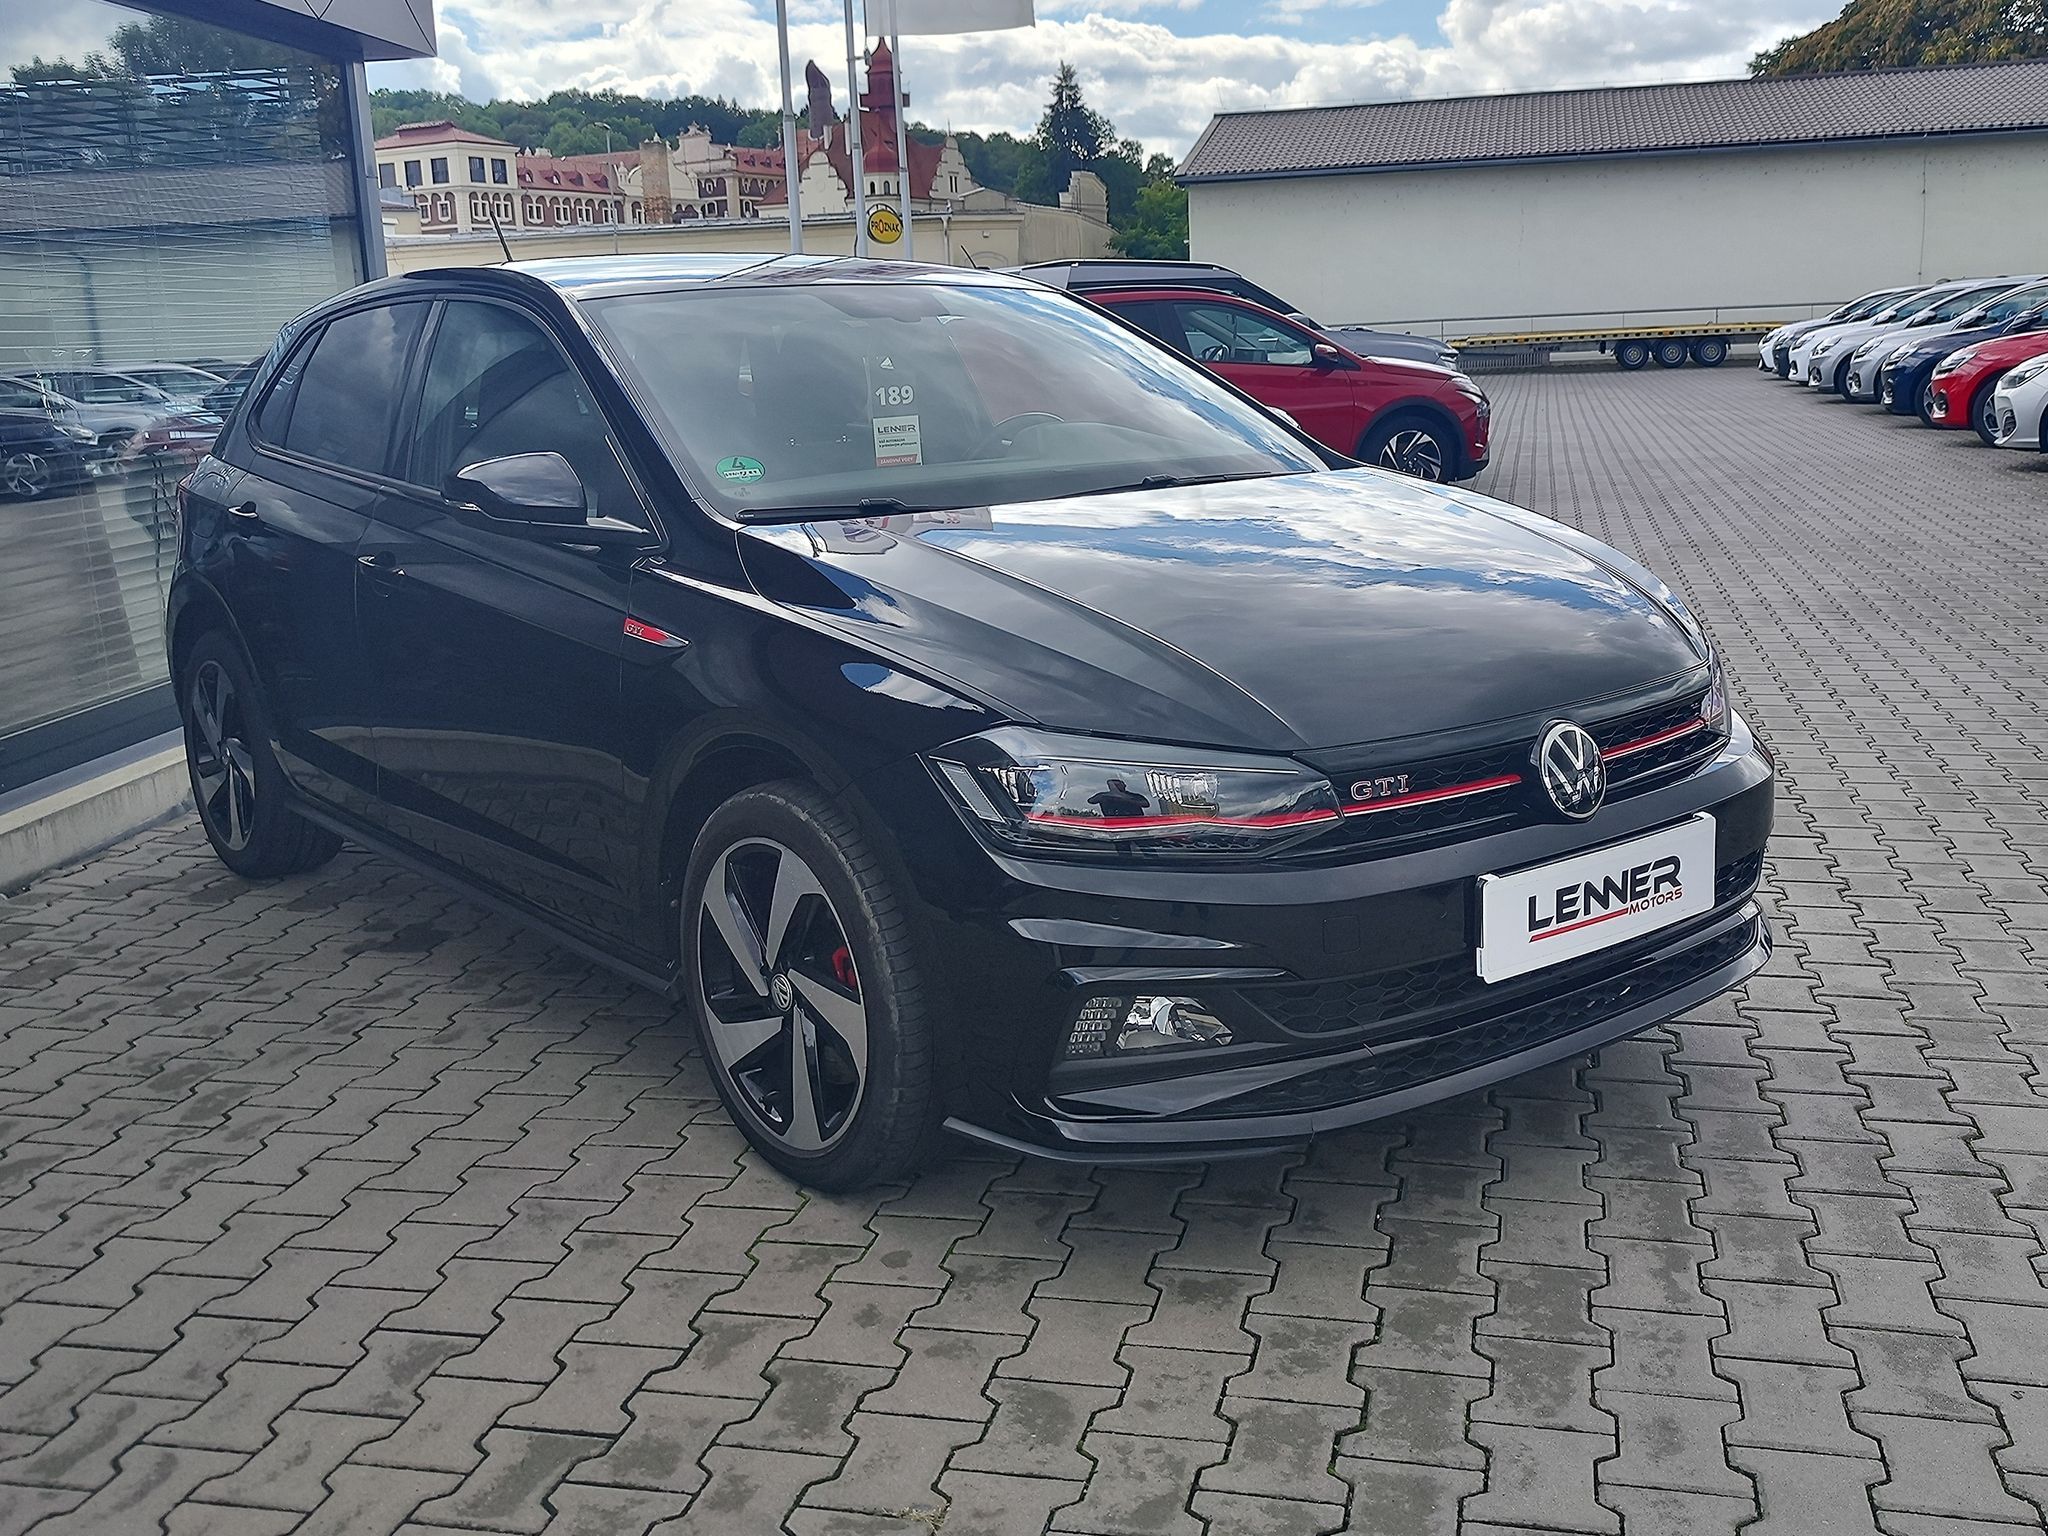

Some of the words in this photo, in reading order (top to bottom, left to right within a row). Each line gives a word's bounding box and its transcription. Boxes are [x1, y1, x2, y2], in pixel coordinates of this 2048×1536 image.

[875, 385, 915, 406] 189
[877, 424, 917, 434] LENNER
[732, 457, 746, 470] 4
[626, 623, 645, 636] GTI
[1350, 774, 1410, 801] GTI
[1528, 855, 1683, 933] LENNER
[1628, 887, 1683, 916] MOTORS
